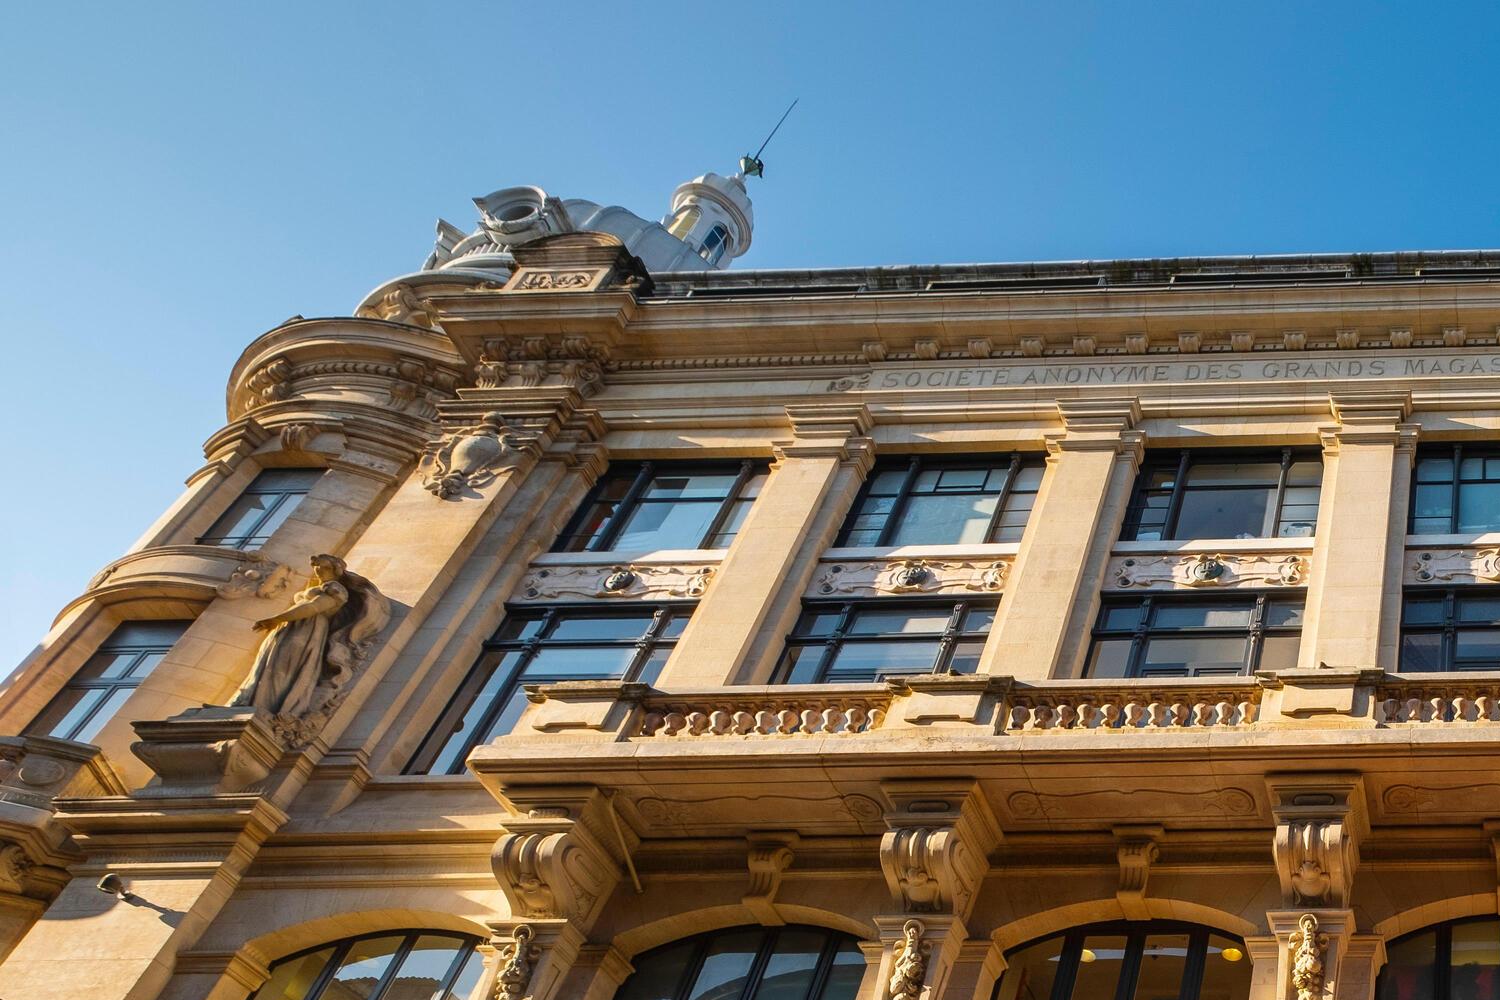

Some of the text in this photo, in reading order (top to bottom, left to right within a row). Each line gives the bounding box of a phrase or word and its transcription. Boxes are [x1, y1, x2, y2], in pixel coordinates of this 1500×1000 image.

[1022, 364, 1170, 385] ANONYME
[1184, 363, 1244, 381] DES
[1262, 360, 1386, 379] GRANDS
